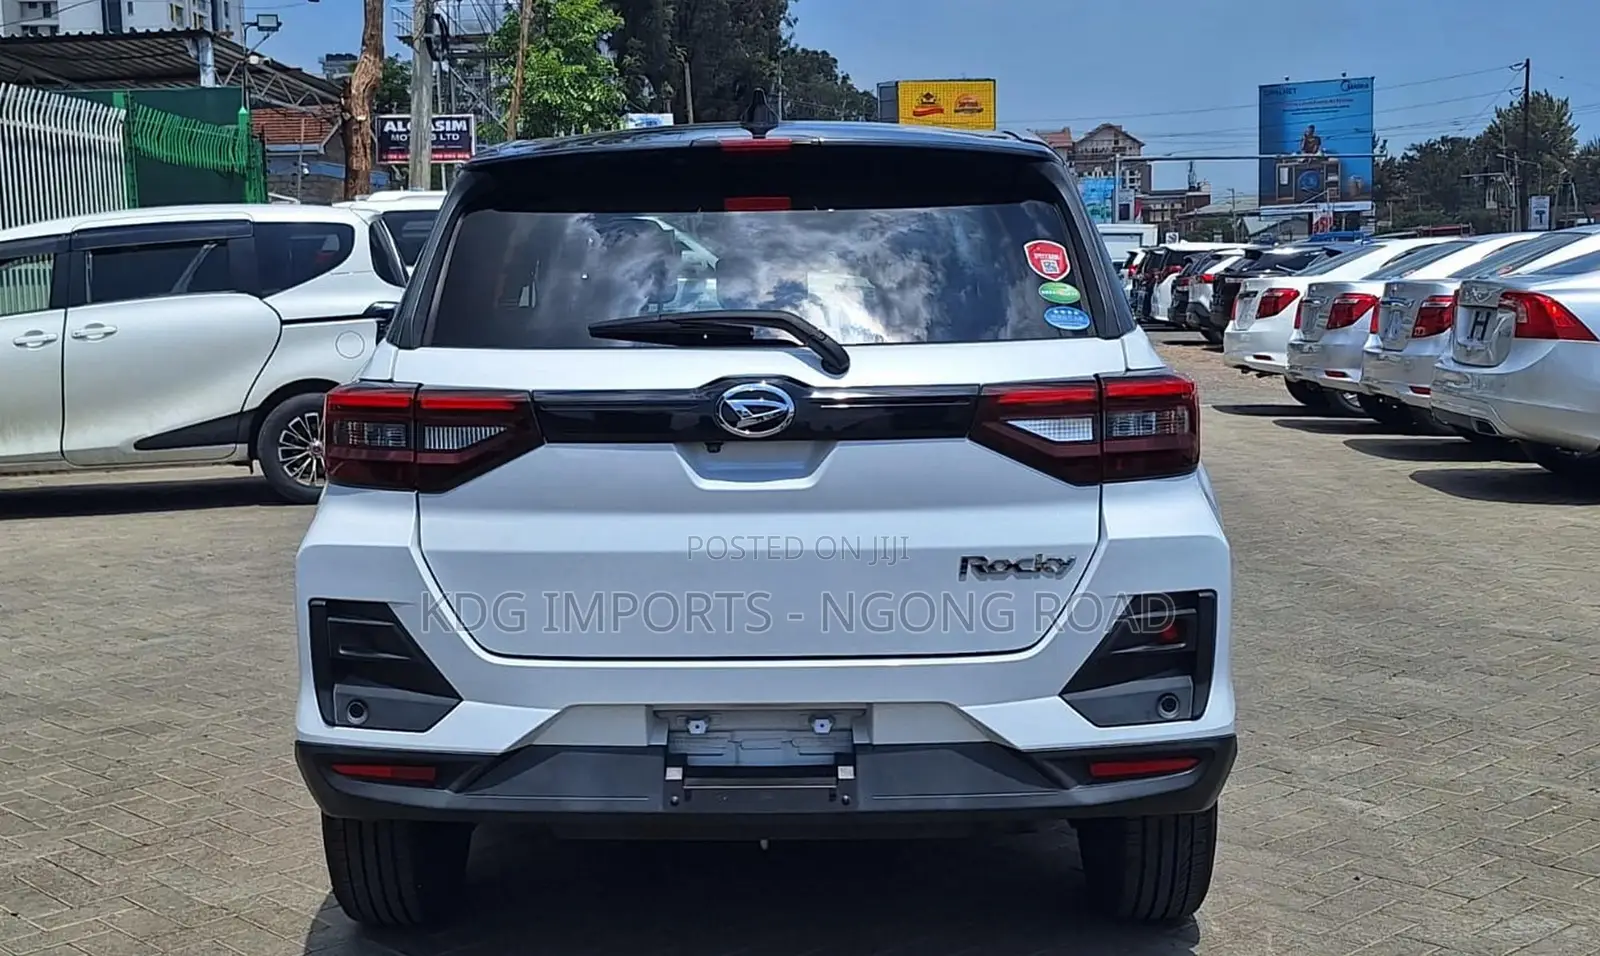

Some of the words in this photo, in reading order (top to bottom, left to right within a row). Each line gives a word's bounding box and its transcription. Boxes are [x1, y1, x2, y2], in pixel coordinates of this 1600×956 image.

[383, 120, 467, 132] ALSIM
[439, 133, 460, 141] LTD
[958, 553, 1077, 581] Rocky
